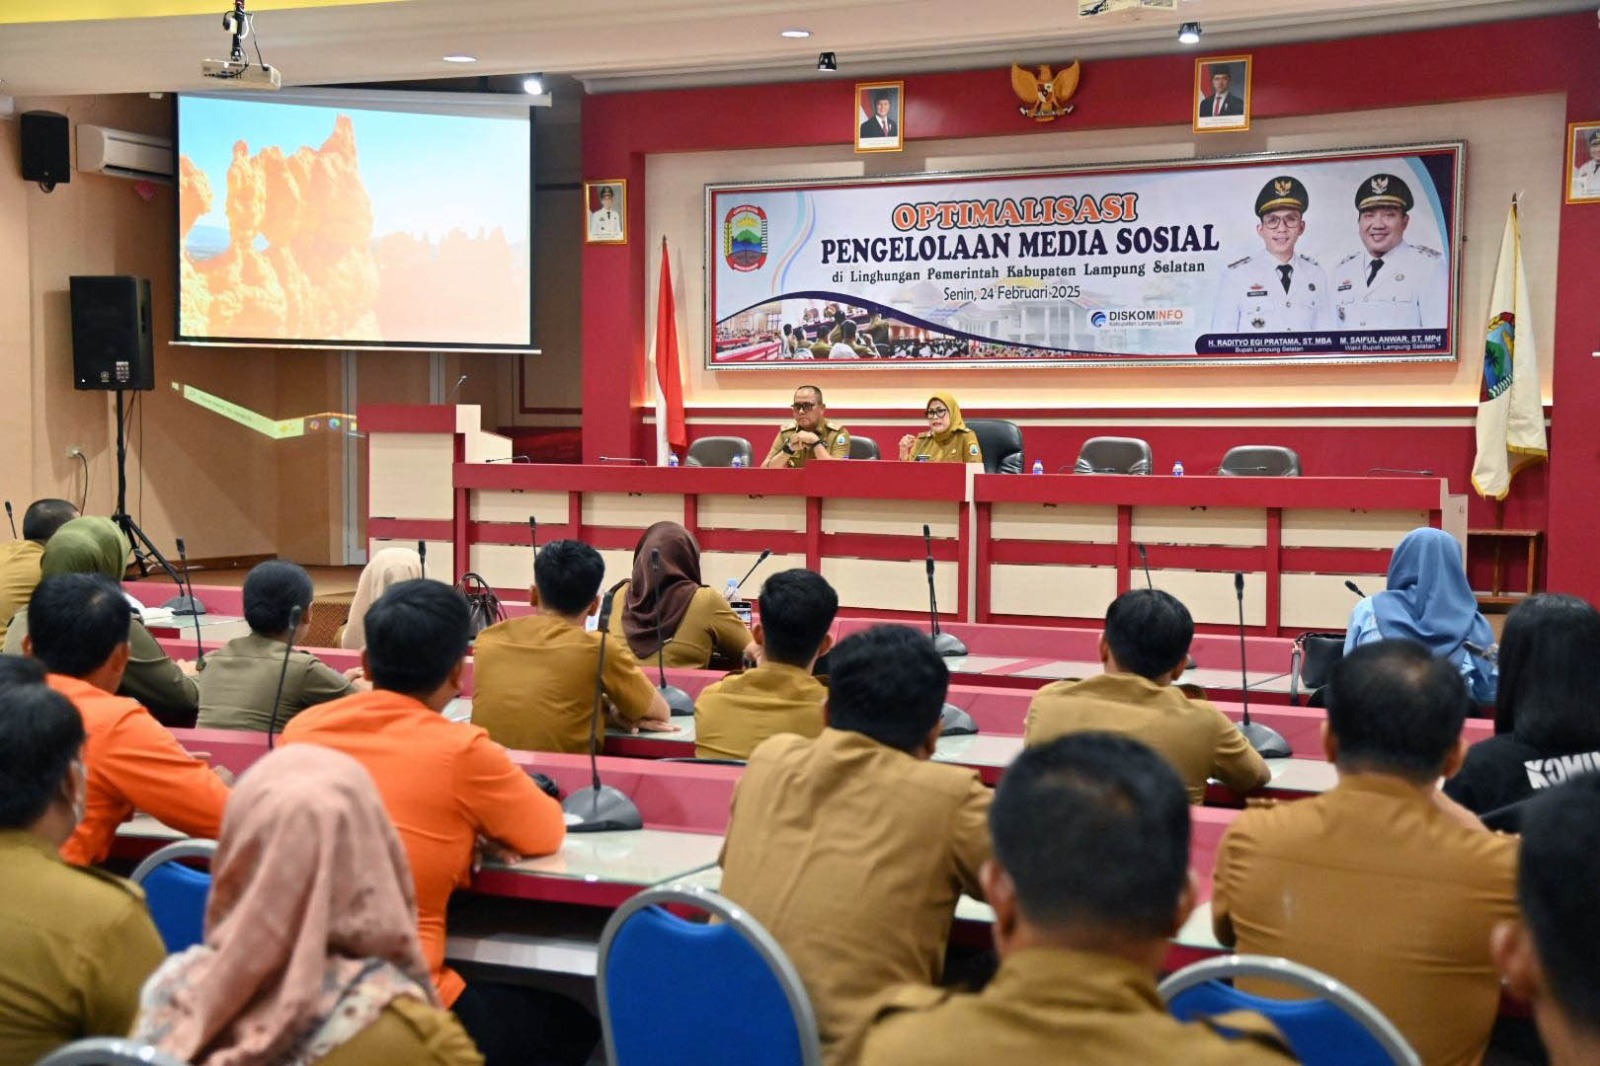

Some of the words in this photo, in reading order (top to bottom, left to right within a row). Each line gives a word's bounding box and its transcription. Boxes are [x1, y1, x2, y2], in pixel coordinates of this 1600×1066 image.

[892, 192, 1138, 232] OPTIMALISASI
[821, 233, 1010, 264] PENGELOLAAN
[1018, 229, 1108, 258] MEDIA
[1116, 224, 1220, 254] SOSIAL
[832, 271, 844, 282] di
[850, 270, 920, 285] Lingkungan
[927, 267, 999, 280] Pemerintah
[1006, 265, 1076, 279] Kabupaten
[1084, 263, 1146, 278] Lampung
[1153, 260, 1206, 273] Selatan
[943, 287, 977, 302] Senin,
[980, 287, 994, 300] 24
[997, 285, 1048, 300] Februari
[1051, 286, 1080, 299] 2025
[1109, 309, 1184, 321] DISKOMINFO
[1217, 338, 1249, 347] RADITYO
[1250, 338, 1263, 347] EGI
[1315, 337, 1332, 345] MBA
[1350, 336, 1377, 344] SAIFUL
